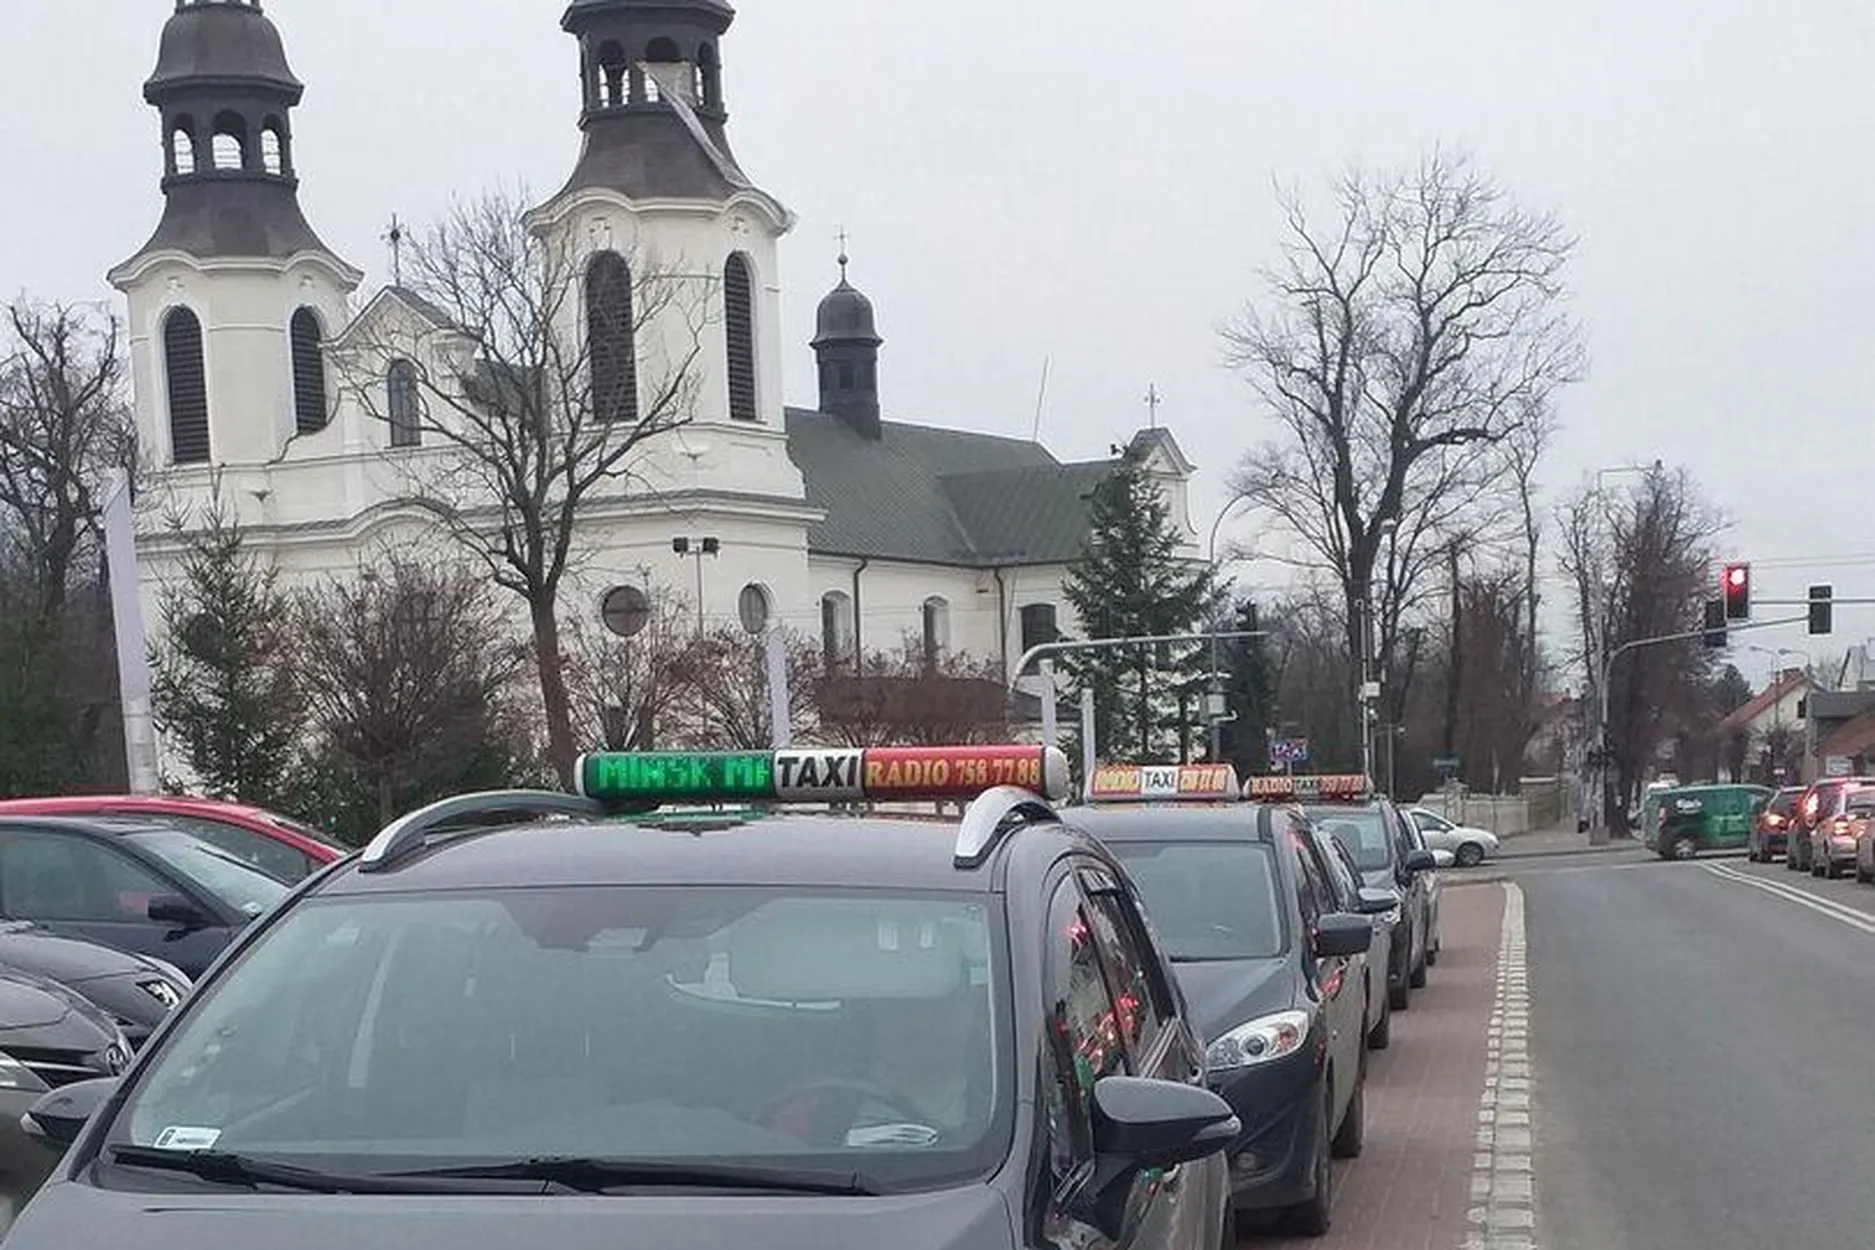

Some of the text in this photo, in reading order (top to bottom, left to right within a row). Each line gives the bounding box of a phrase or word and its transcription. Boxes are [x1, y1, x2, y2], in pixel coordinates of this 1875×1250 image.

[777, 756, 856, 788] TAXI
[864, 758, 950, 788] RADIO
[1143, 770, 1176, 788] TAXI
